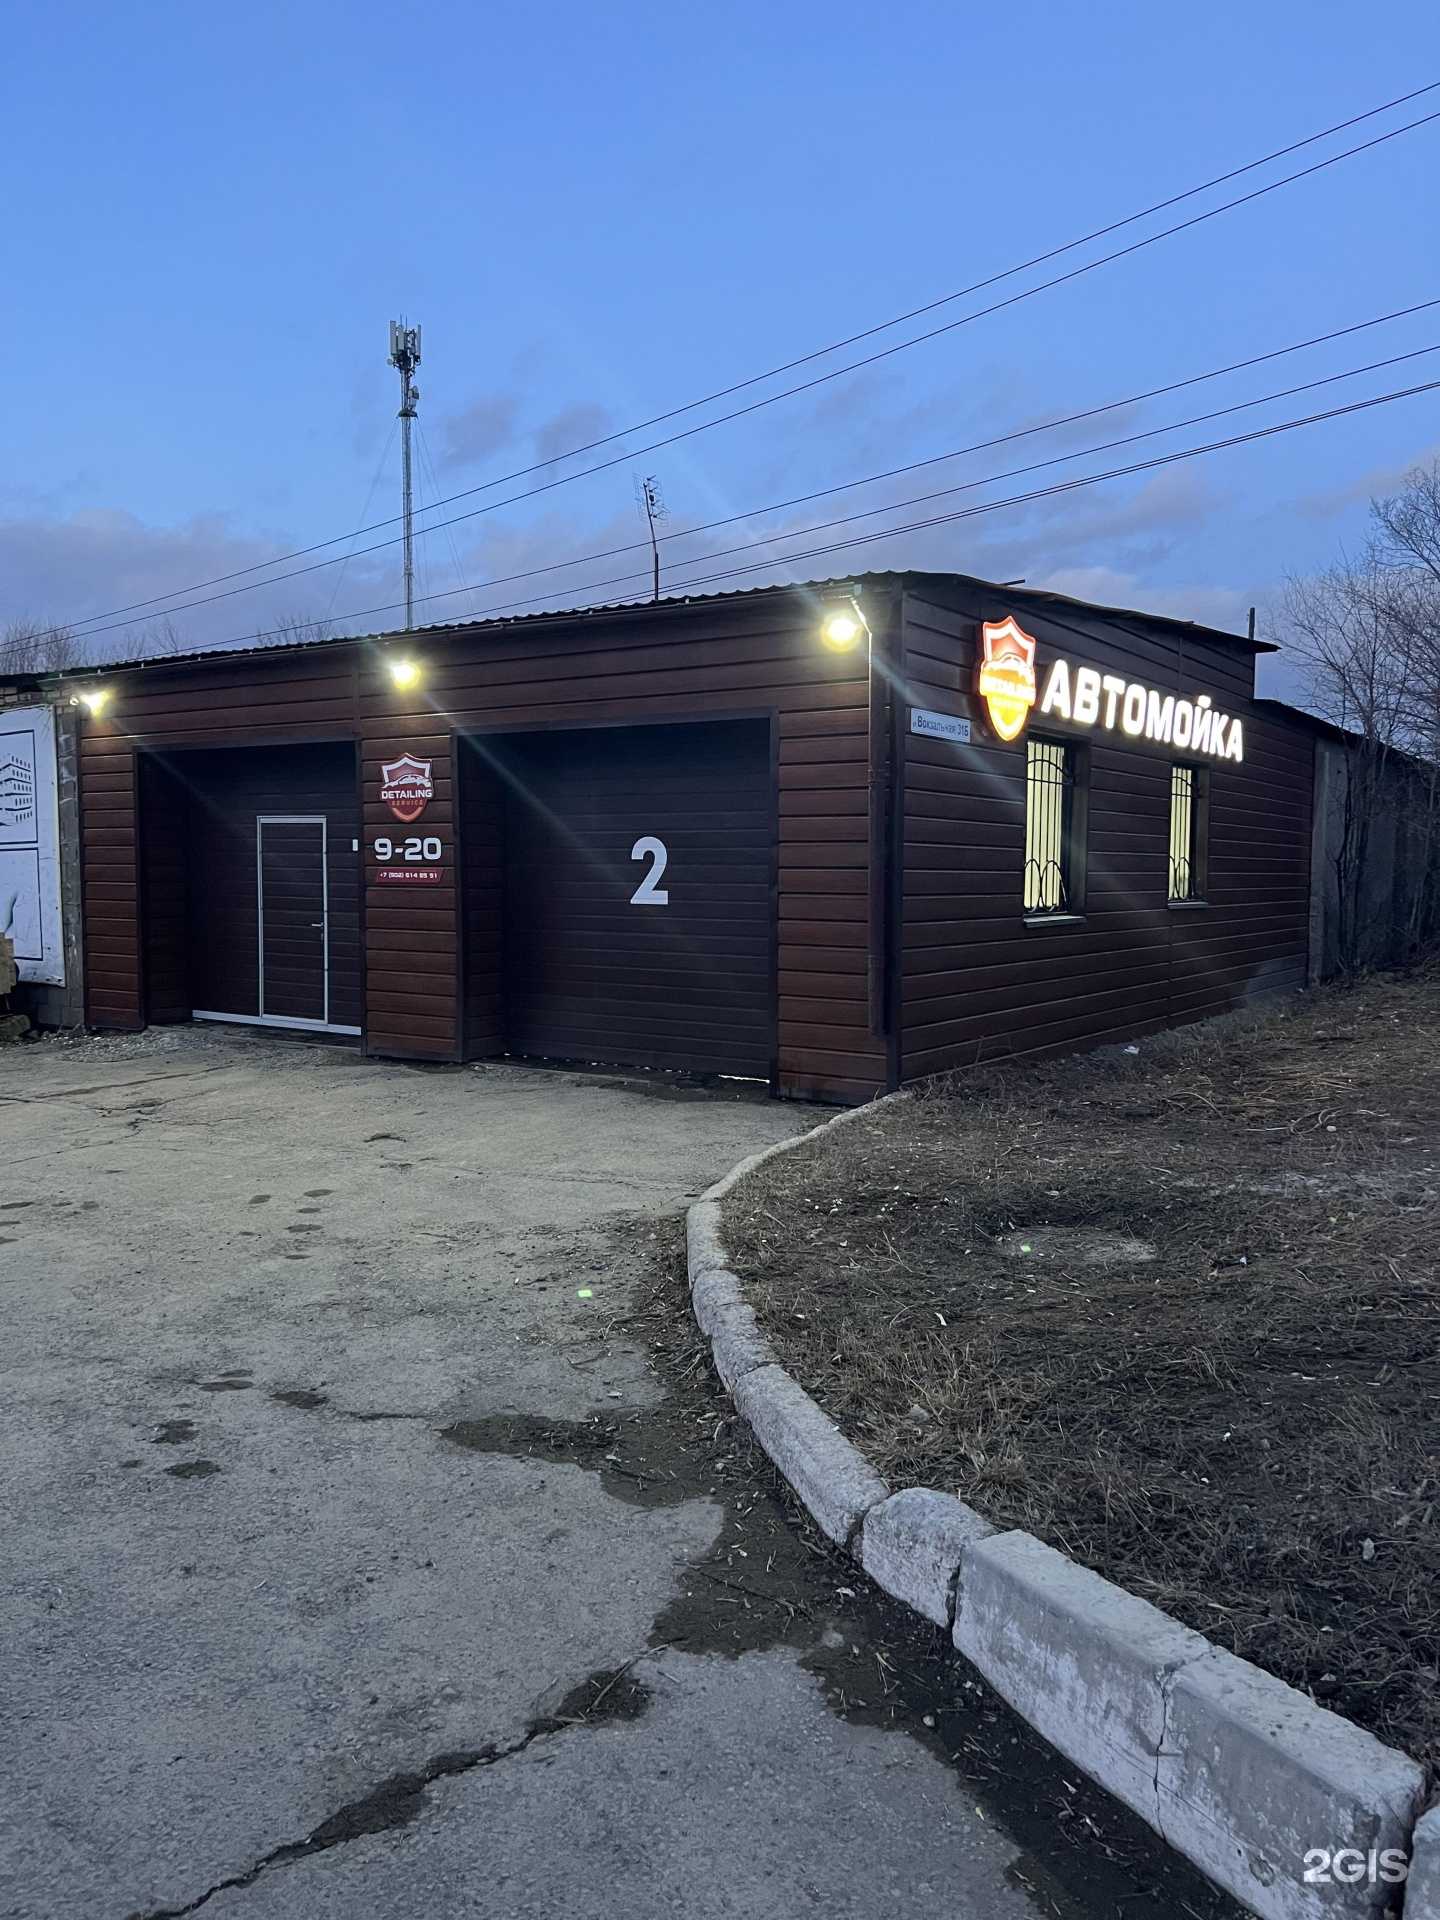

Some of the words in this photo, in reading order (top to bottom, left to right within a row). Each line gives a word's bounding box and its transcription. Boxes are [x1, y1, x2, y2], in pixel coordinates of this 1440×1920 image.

[1041, 659, 1243, 763] АВТОМОЙКА
[381, 789, 432, 799] DETAILING
[374, 837, 442, 861] 9-20
[630, 836, 669, 905] 2
